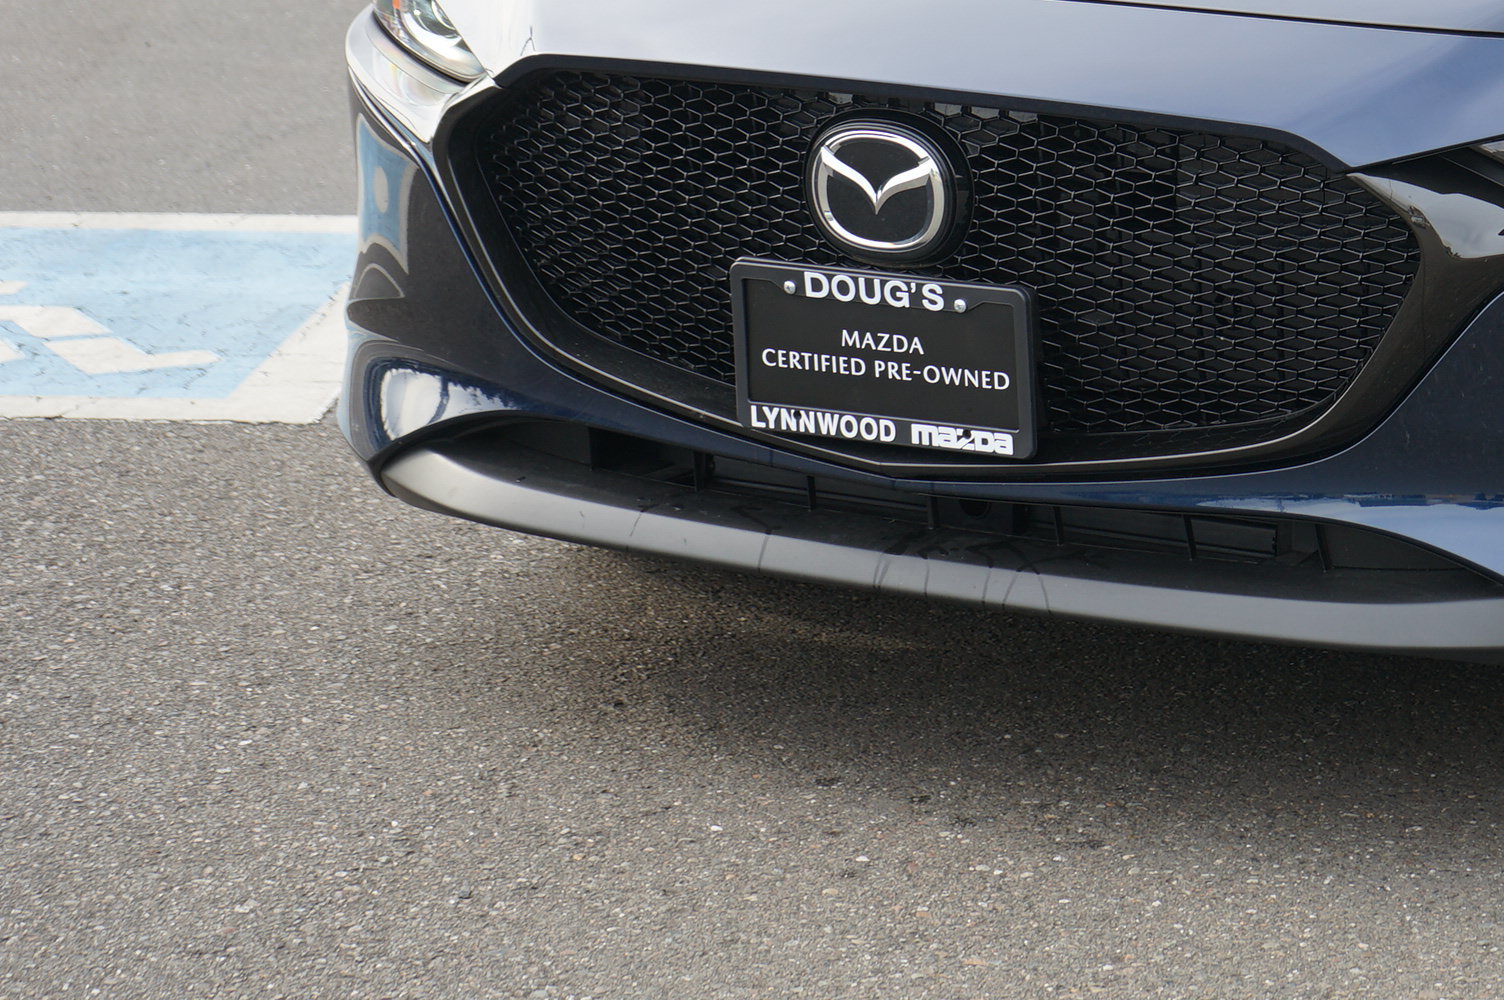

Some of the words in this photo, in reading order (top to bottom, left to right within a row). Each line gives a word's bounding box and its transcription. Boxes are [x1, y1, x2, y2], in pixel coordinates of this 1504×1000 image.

[804, 271, 944, 311] DOUG'S
[841, 329, 925, 355] MAZDA
[762, 348, 866, 377] CERTIFIED
[875, 360, 1010, 391] PRE-OWNED
[751, 405, 896, 443] LYNNWOOD
